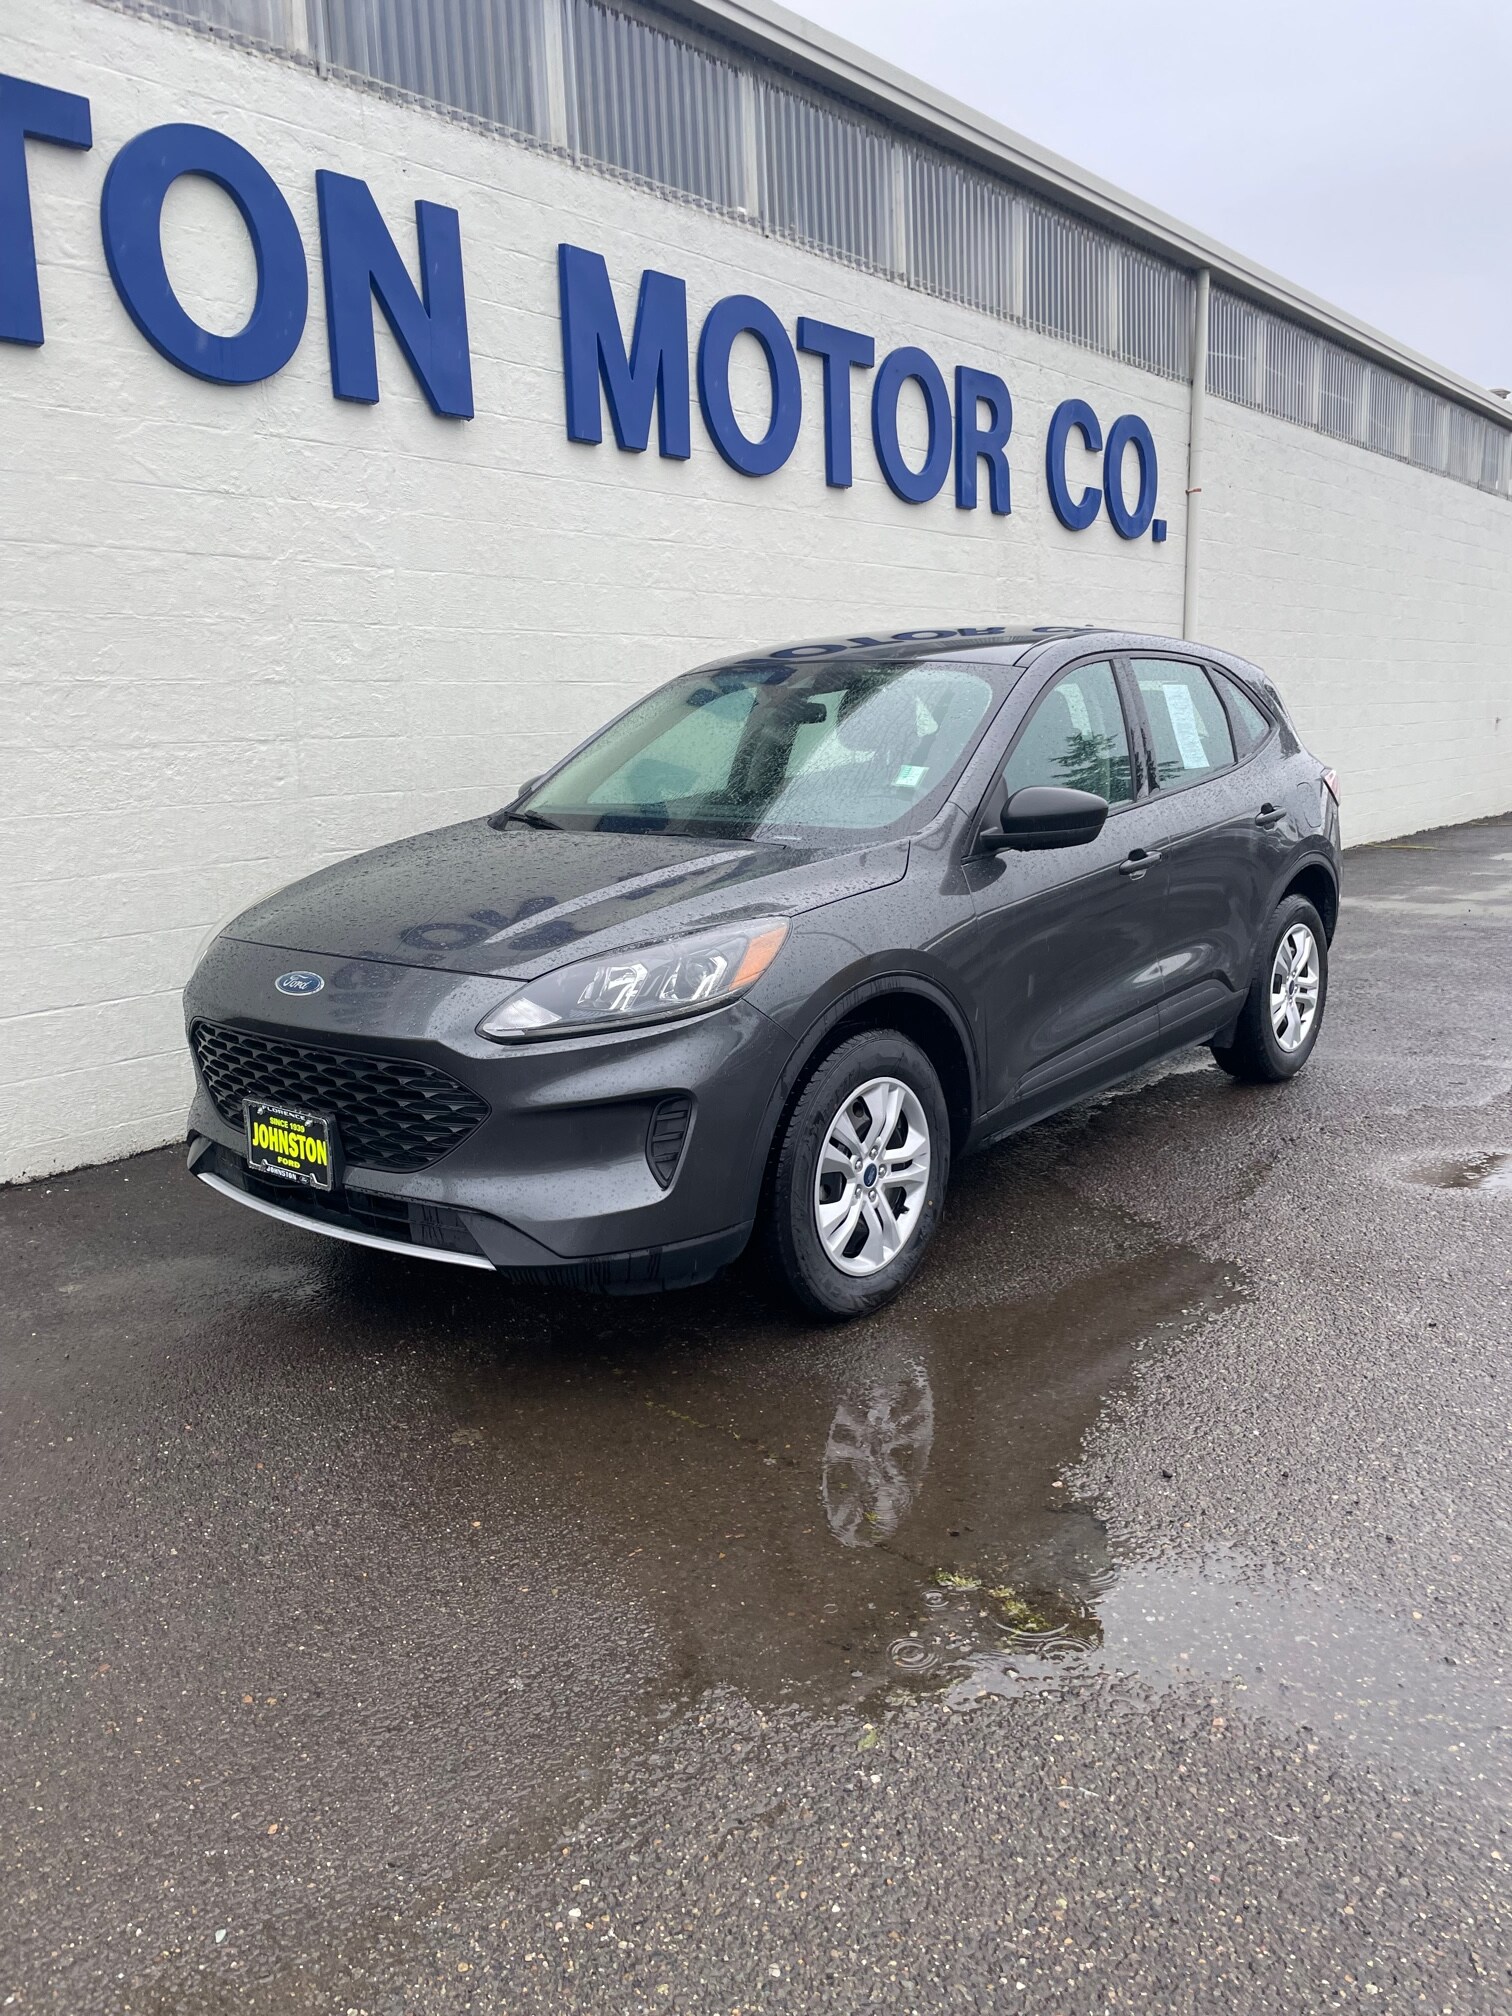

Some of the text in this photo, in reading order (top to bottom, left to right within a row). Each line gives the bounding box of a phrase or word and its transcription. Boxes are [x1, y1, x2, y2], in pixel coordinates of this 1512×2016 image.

[558, 243, 1012, 516] MOTOR
[1045, 399, 1167, 543] CO.
[269, 1117, 289, 1129] SINCE
[252, 1122, 328, 1166] JOHNSTON
[277, 1156, 301, 1169] FORD
